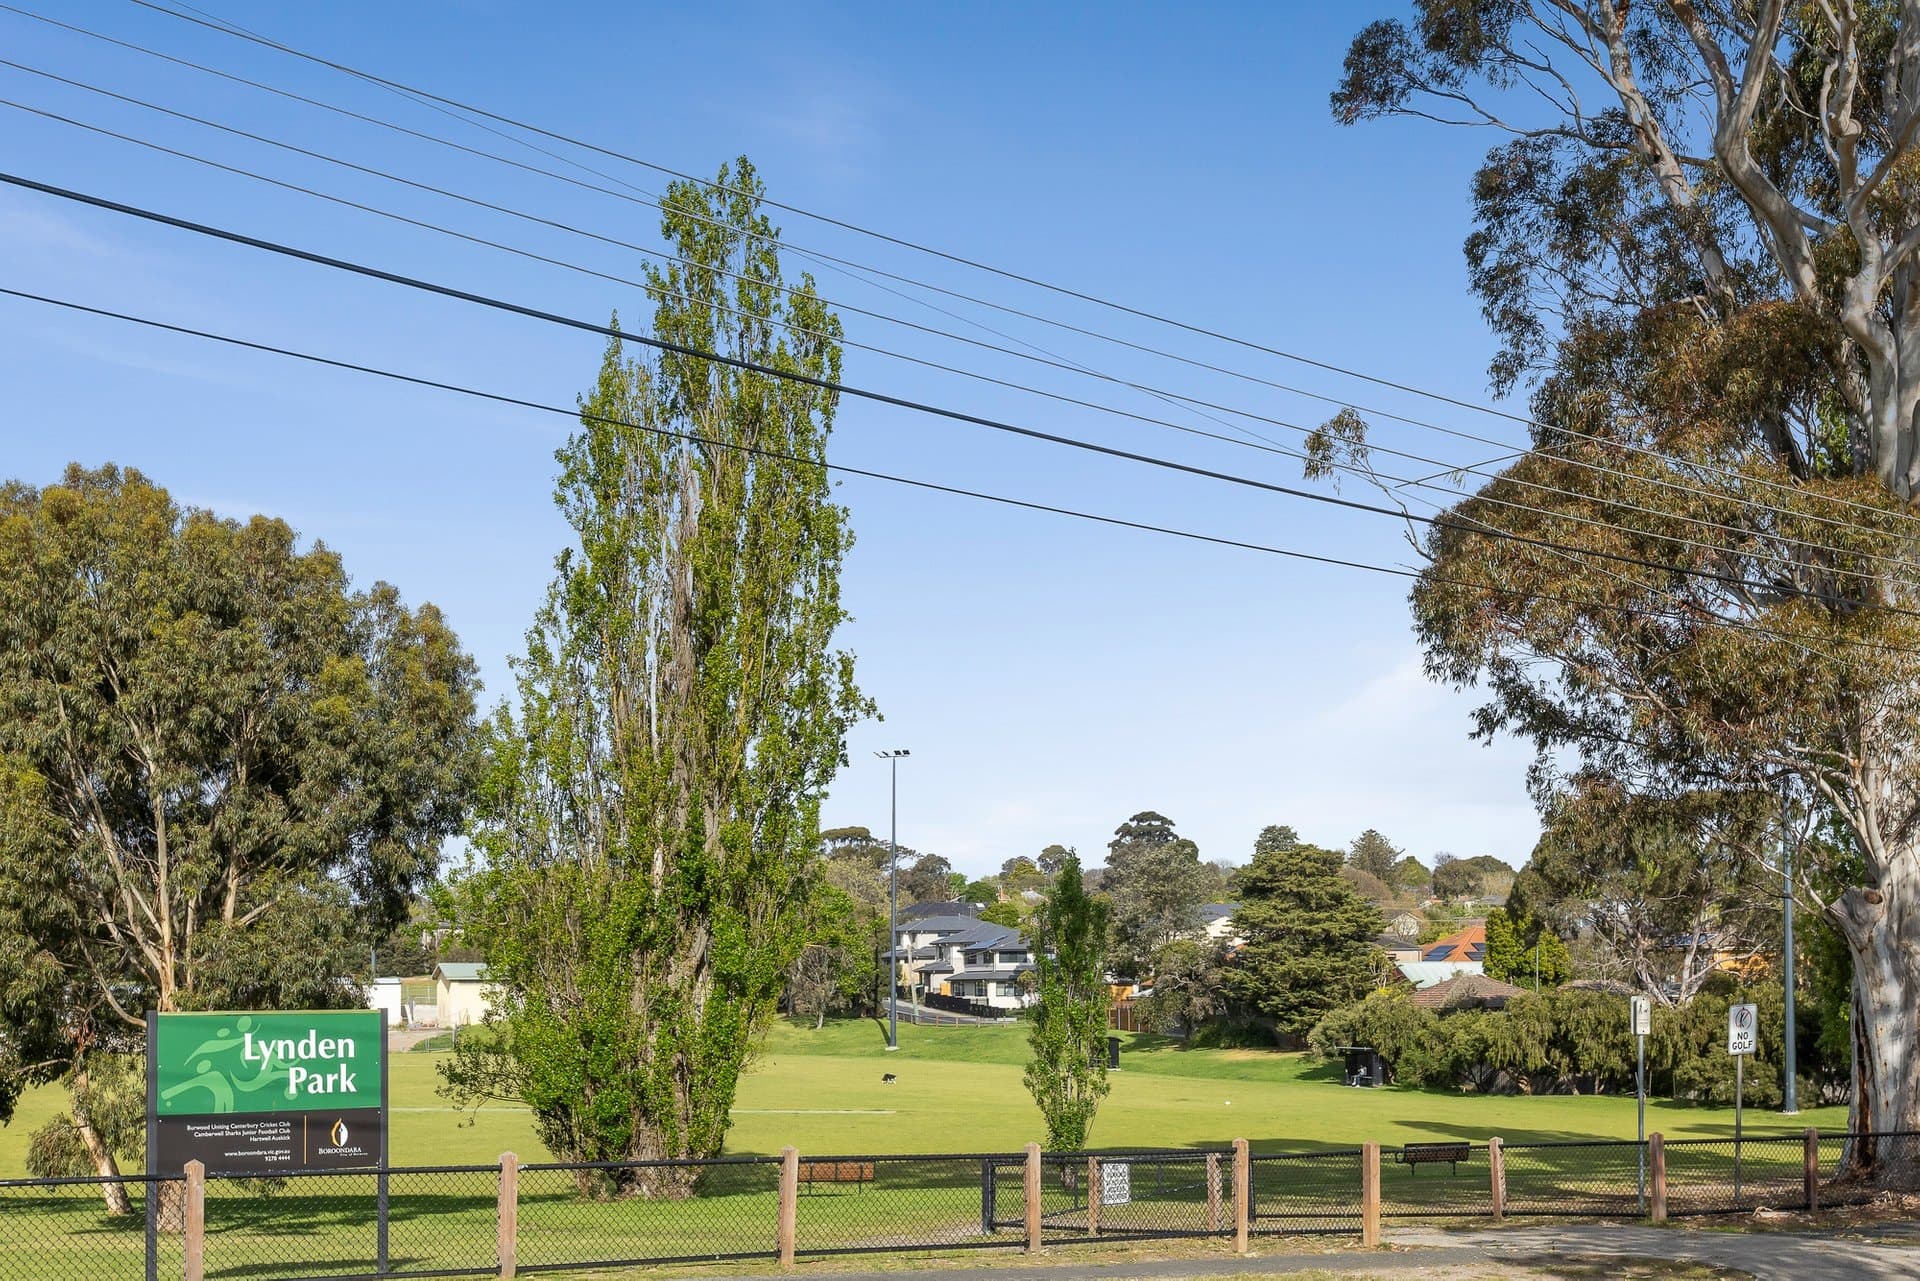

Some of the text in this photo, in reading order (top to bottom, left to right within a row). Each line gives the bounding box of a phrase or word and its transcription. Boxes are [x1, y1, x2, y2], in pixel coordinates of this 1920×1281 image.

[1737, 1031, 1749, 1040] NO
[244, 1029, 355, 1070] Lynden
[1732, 1040, 1753, 1050] GOLF
[289, 1063, 357, 1094] Park
[230, 1122, 258, 1130] Canterbury
[224, 1149, 291, 1157] www.boroondara.vic.gov.au
[318, 1147, 362, 1155] BOROONDARA
